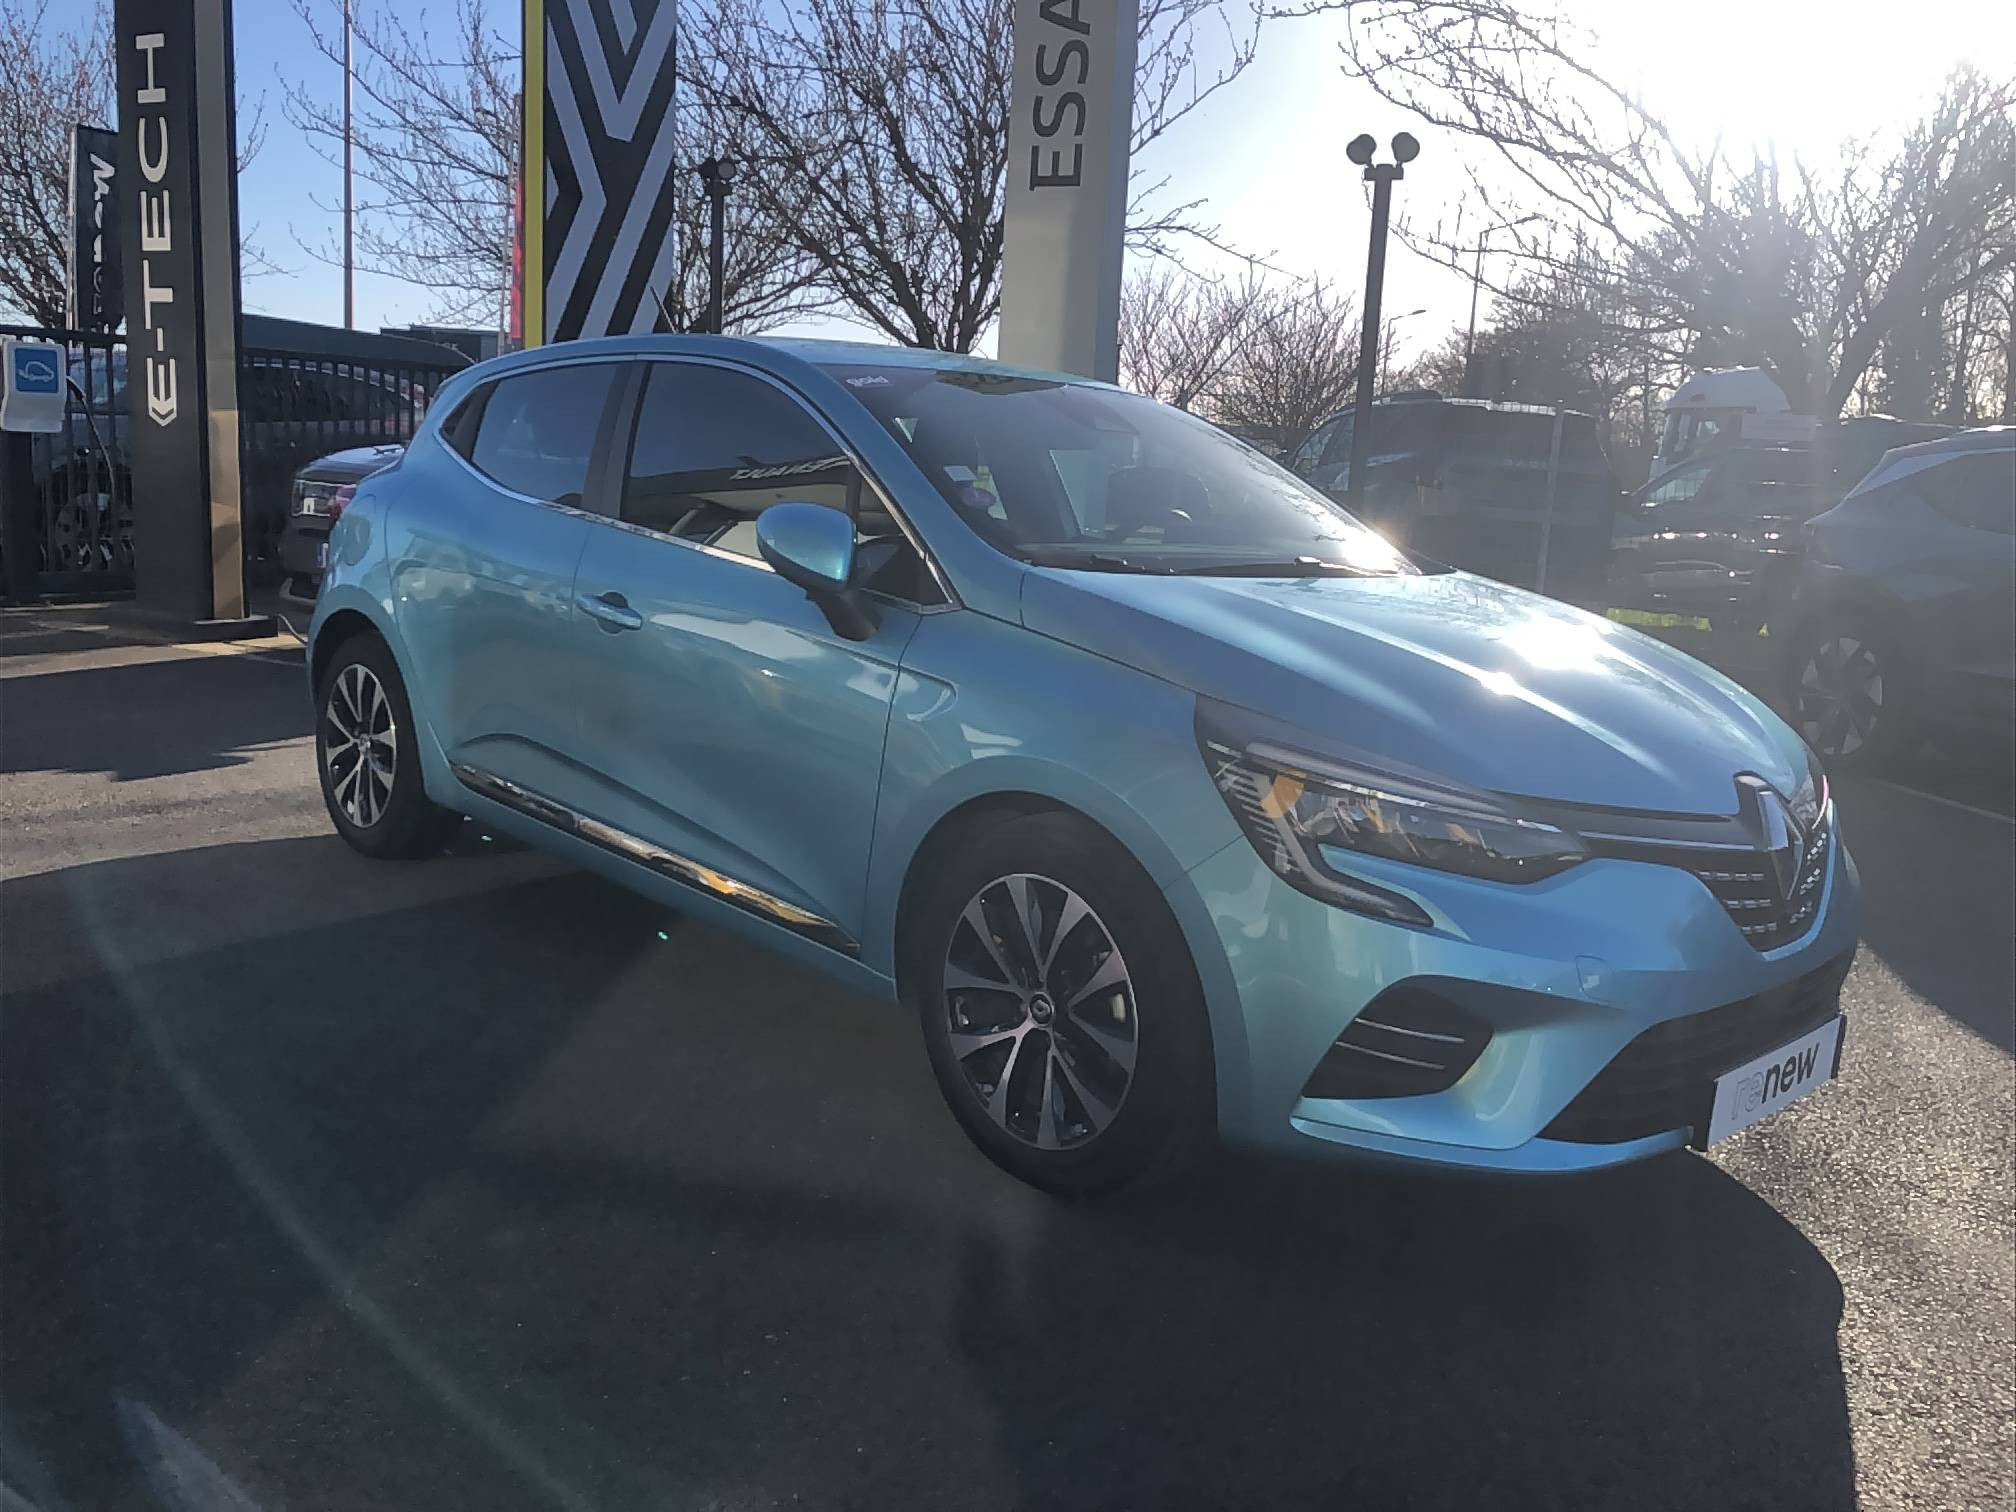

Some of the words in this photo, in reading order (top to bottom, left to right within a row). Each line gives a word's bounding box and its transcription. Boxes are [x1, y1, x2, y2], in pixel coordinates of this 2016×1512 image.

[1029, 0, 1091, 191] ESSA
[135, 33, 178, 426] E-TECH
[1730, 1041, 1820, 1120] renew
